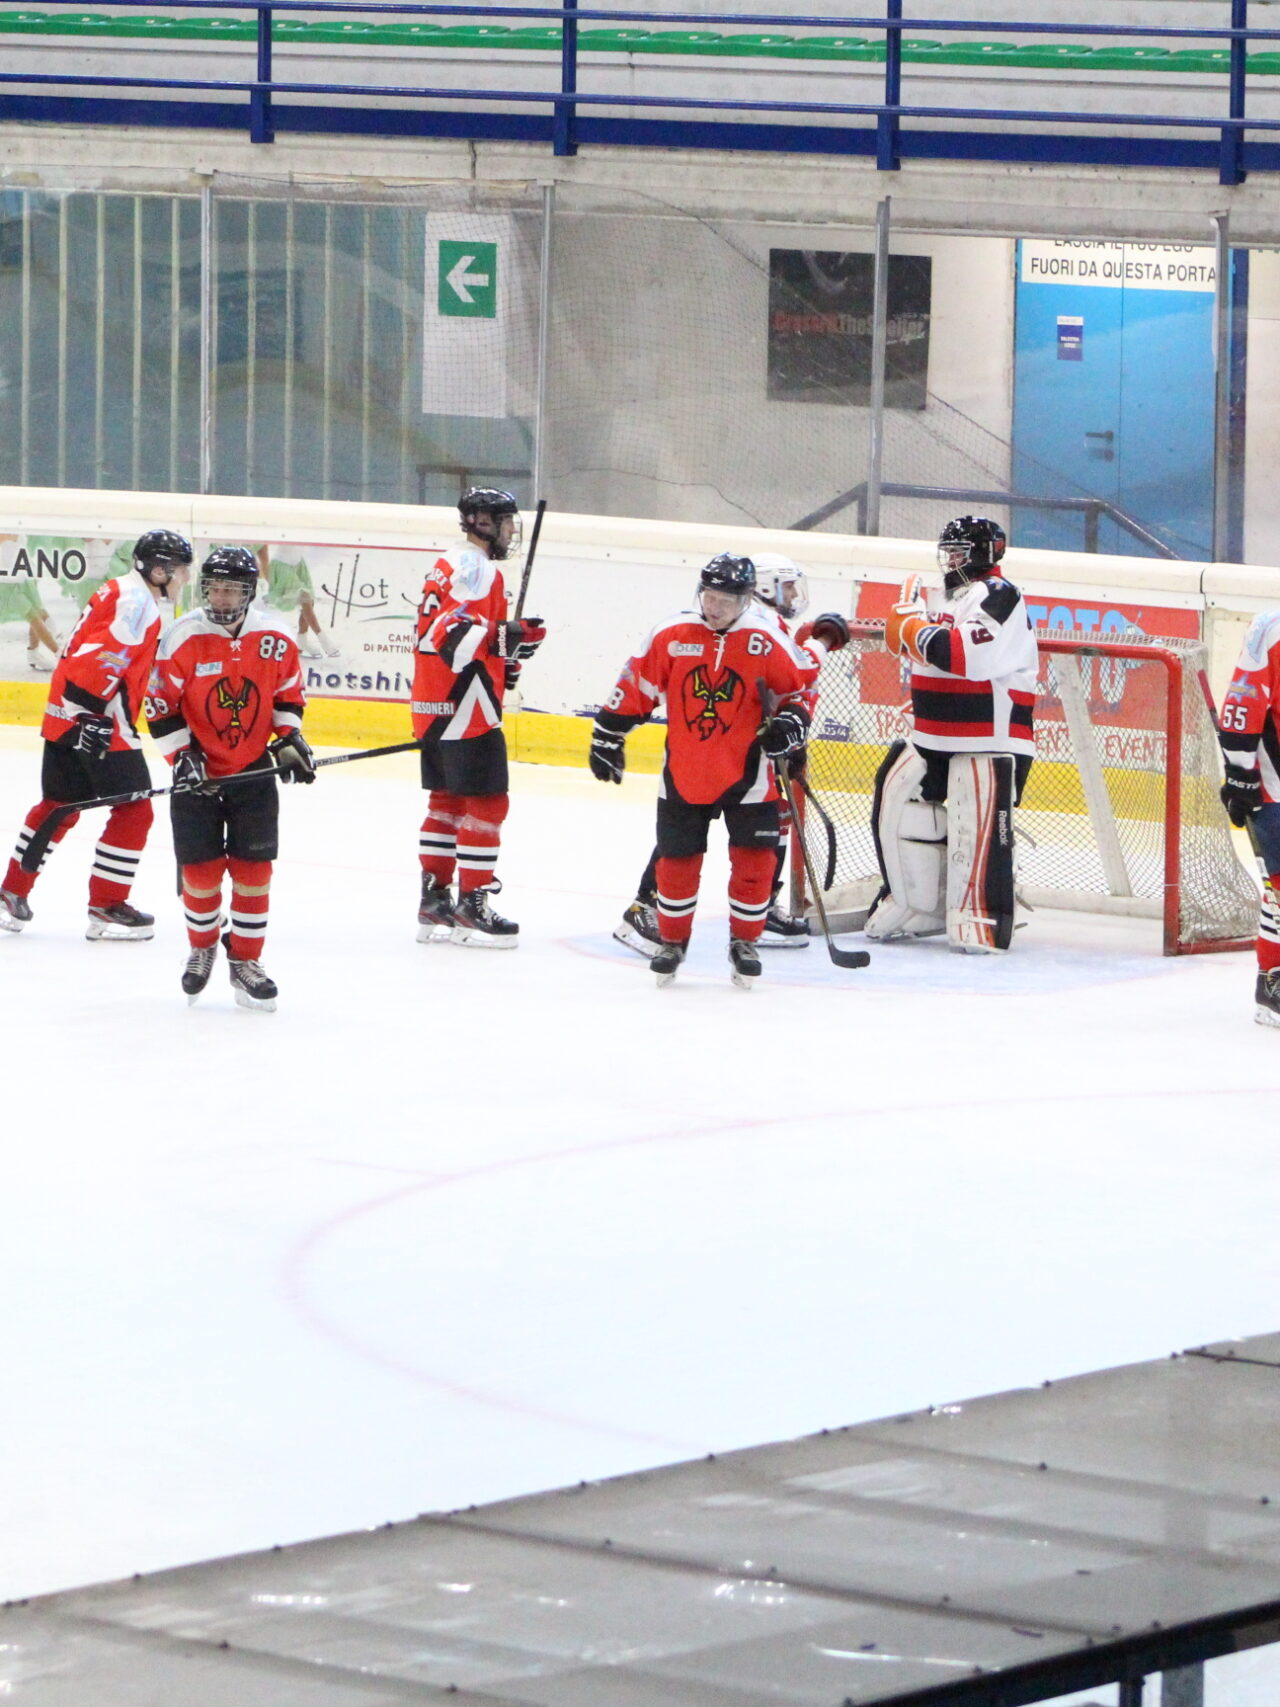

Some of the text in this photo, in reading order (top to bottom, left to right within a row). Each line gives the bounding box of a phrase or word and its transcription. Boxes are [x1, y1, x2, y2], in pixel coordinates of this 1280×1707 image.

[1031, 257, 1217, 284] FUORI DA QUESTA PORTA
[498, 623, 509, 658] Reebok
[102, 674, 119, 698] 7
[1222, 704, 1249, 731] 55
[996, 808, 1009, 848] Reebok
